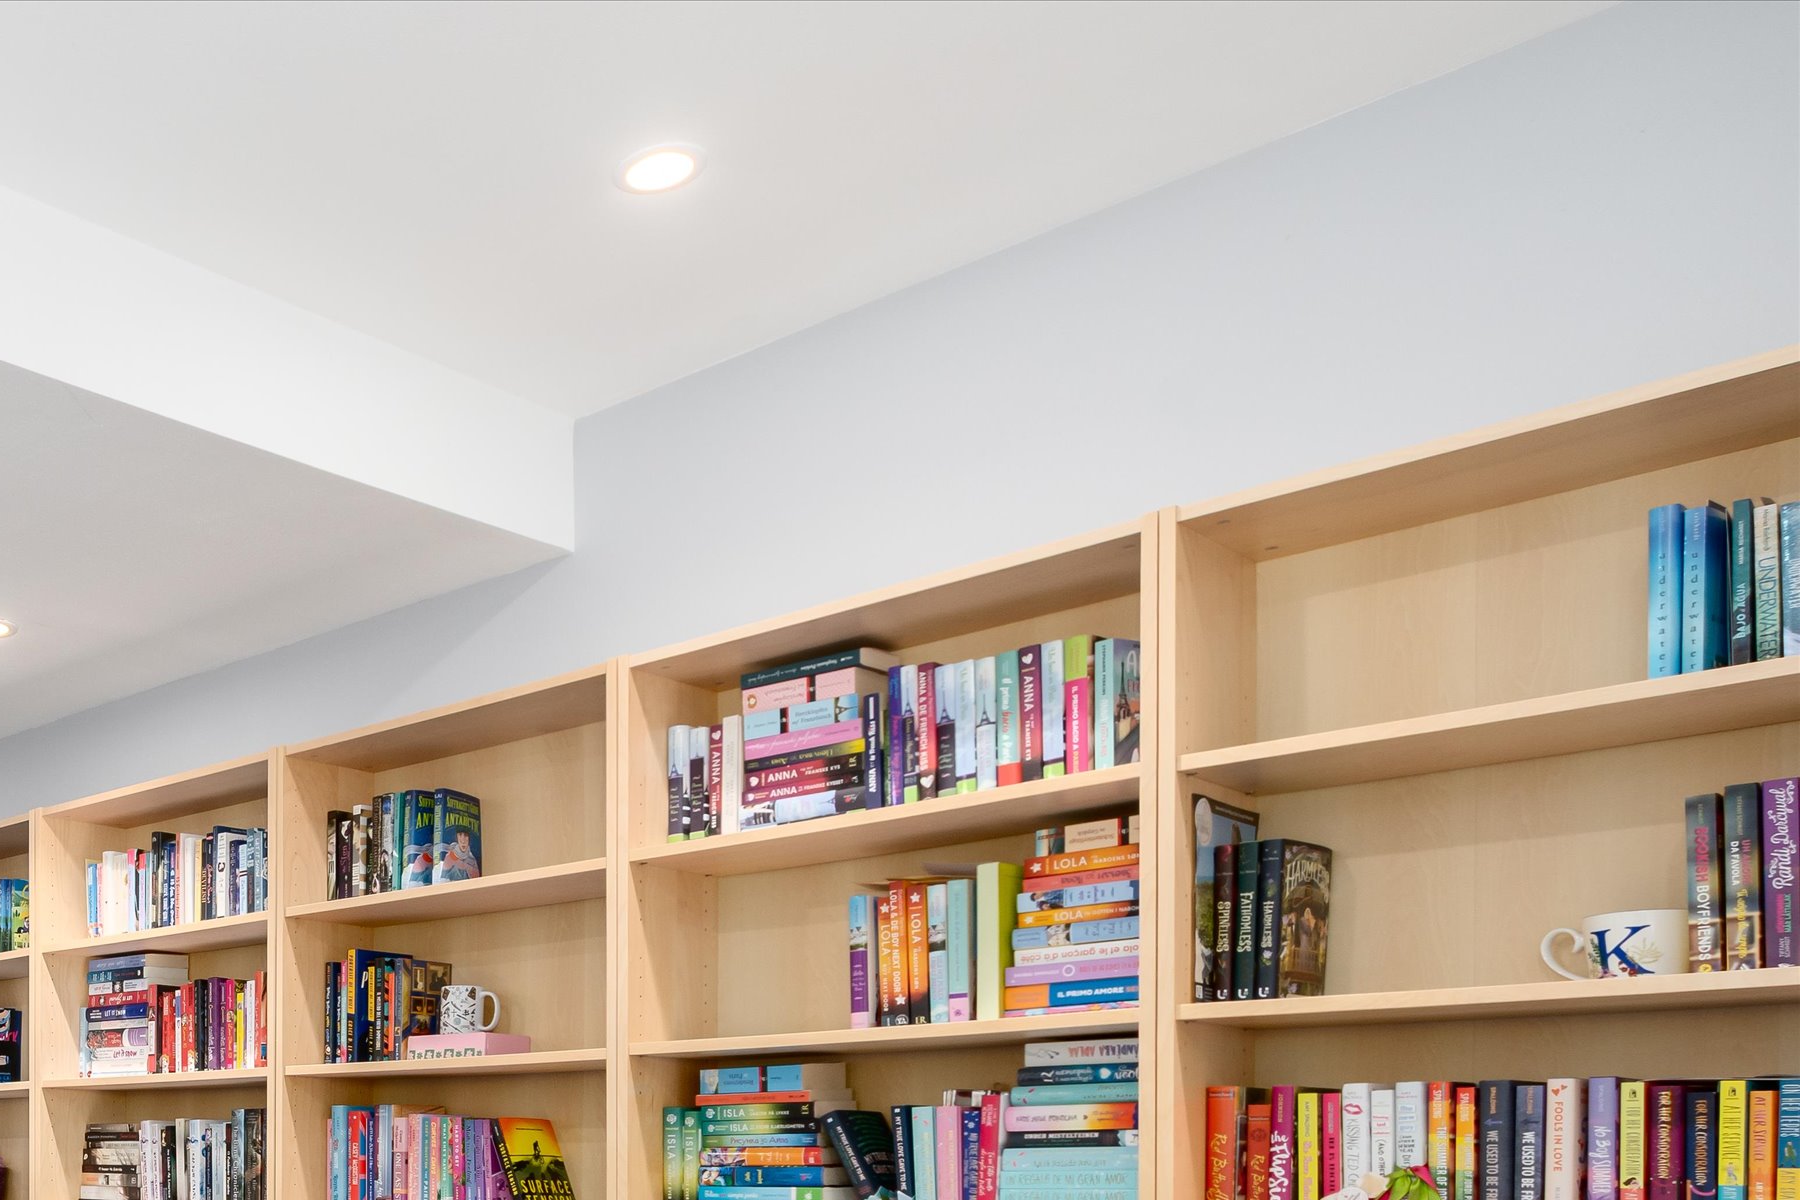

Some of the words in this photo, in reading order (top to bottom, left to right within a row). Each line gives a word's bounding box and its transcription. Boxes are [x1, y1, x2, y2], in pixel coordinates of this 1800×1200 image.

[1759, 556, 1777, 661] UNDERWATER
[918, 672, 928, 694] ANNA
[1023, 676, 1034, 711] ANNA
[918, 705, 927, 715] DE
[918, 717, 927, 749] FRENCH
[711, 751, 721, 786] ANNA
[918, 751, 927, 770] KISS
[768, 768, 798, 783] ANNA
[869, 767, 877, 793] ANNA
[770, 786, 798, 798] ANNA
[1730, 841, 1739, 854] DA
[1053, 857, 1087, 870] LOLA
[1730, 856, 1739, 887] FAVOLA
[890, 890, 898, 911] LOLA
[891, 919, 898, 930] DE
[1055, 910, 1083, 921] LOLA
[1237, 891, 1254, 953] FATHOMLESS
[1261, 901, 1275, 948] HARMLESS
[1697, 884, 1711, 961] BOYFRIENDS
[911, 914, 921, 943] LOLA
[1217, 901, 1231, 953] SPINELESS
[881, 925, 891, 956] LOLA
[891, 932, 900, 947] BOY
[1591, 925, 1654, 974] K
[892, 949, 901, 970] NEXT
[893, 971, 901, 993] DOOR
[1658, 1091, 1671, 1104] FOR
[724, 1108, 745, 1117] ISLA
[895, 1117, 901, 1125] MY
[1554, 1101, 1563, 1133] FOOLS
[730, 1124, 748, 1132] ISLA
[1485, 1130, 1498, 1141] WE
[1520, 1131, 1534, 1142] WE
[668, 1134, 676, 1160] ISLA
[1554, 1137, 1562, 1146] IN
[499, 1143, 511, 1169] SURFACE
[1435, 1143, 1447, 1172] SUMMER
[1485, 1142, 1498, 1163] USED
[1520, 1143, 1534, 1164] USED
[1553, 1149, 1562, 1171] LOVE
[1485, 1164, 1498, 1174] TO
[1520, 1165, 1534, 1176] TO
[520, 1179, 571, 1194] SURFACE
[1485, 1176, 1498, 1186] BE
[1520, 1177, 1534, 1188] BE
